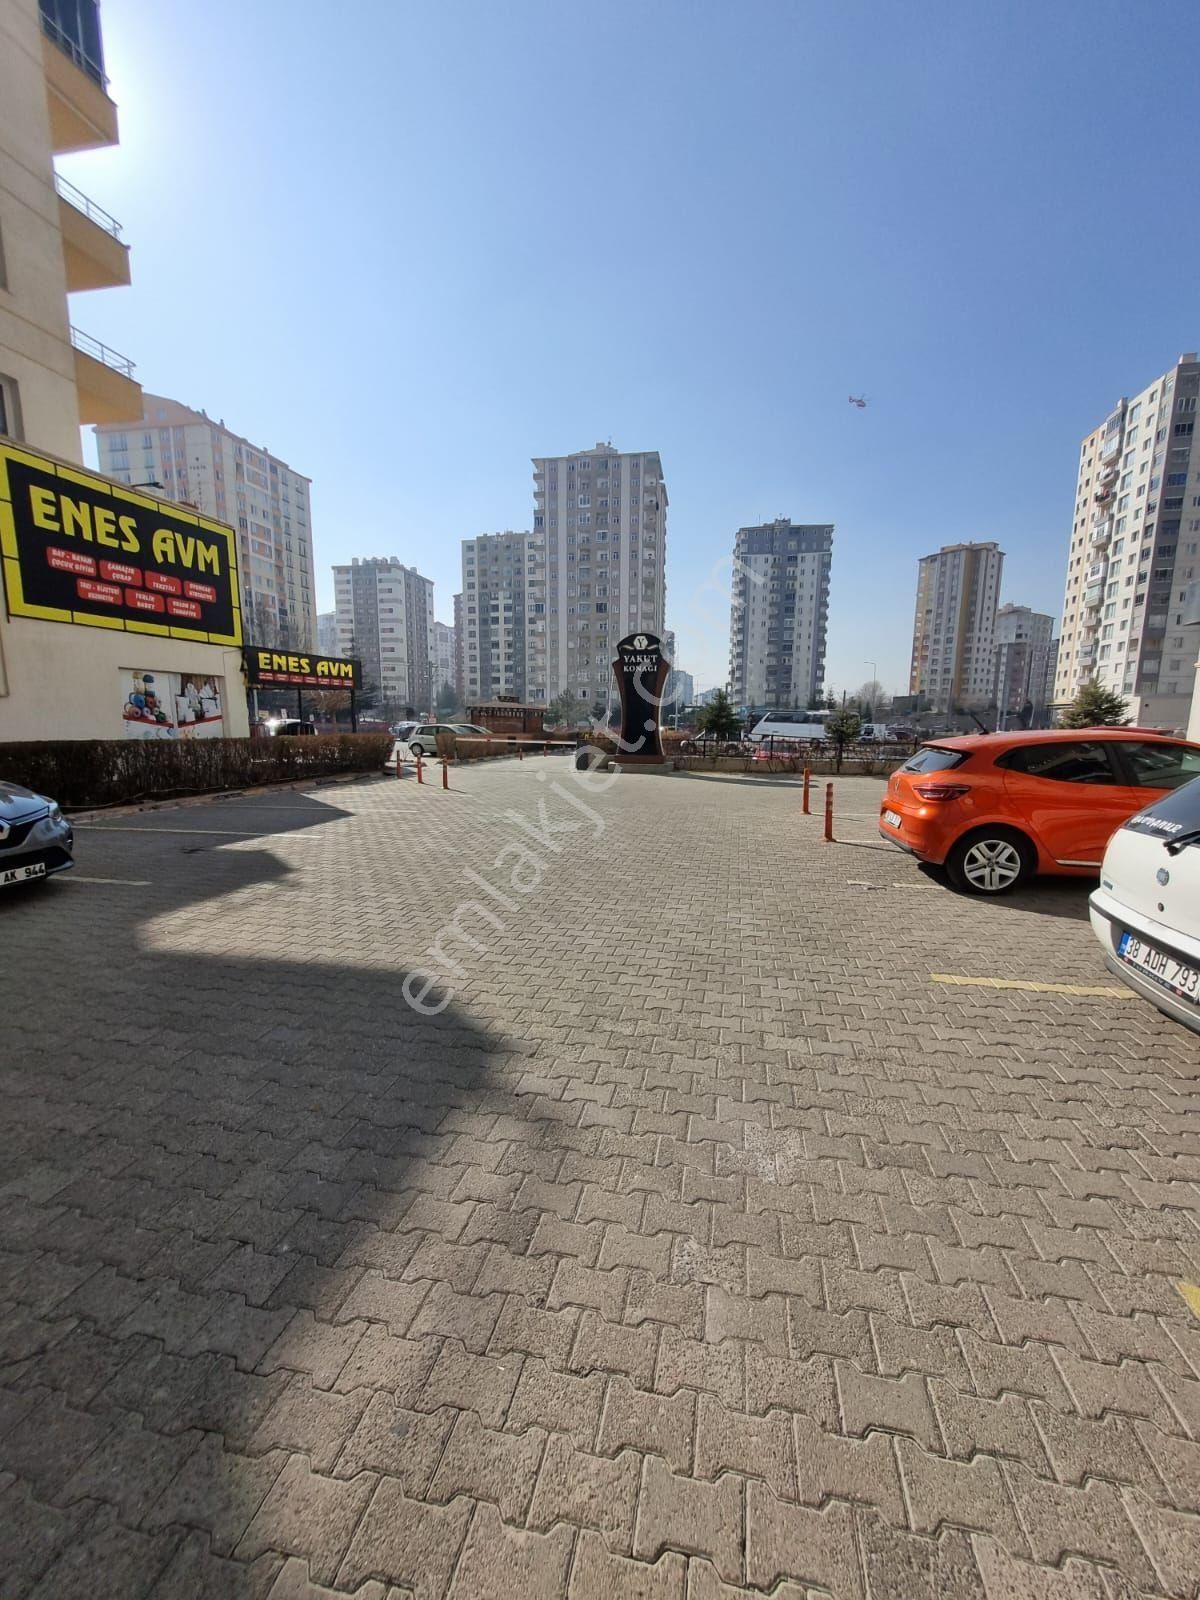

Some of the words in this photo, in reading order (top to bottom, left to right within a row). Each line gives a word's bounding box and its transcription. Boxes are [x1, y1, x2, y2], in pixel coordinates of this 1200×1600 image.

[29, 484, 141, 553] ENES
[152, 528, 220, 576] AVM
[51, 558, 74, 569] ÇOCUK
[112, 572, 132, 582] ÇORAP
[258, 652, 311, 674] ENES
[316, 660, 353, 678] AVM
[623, 655, 658, 663] YAKUT
[4, 870, 17, 883] AK
[1126, 937, 1142, 959] 38
[1142, 948, 1170, 976] ADH
[1170, 962, 1199, 992] 793
